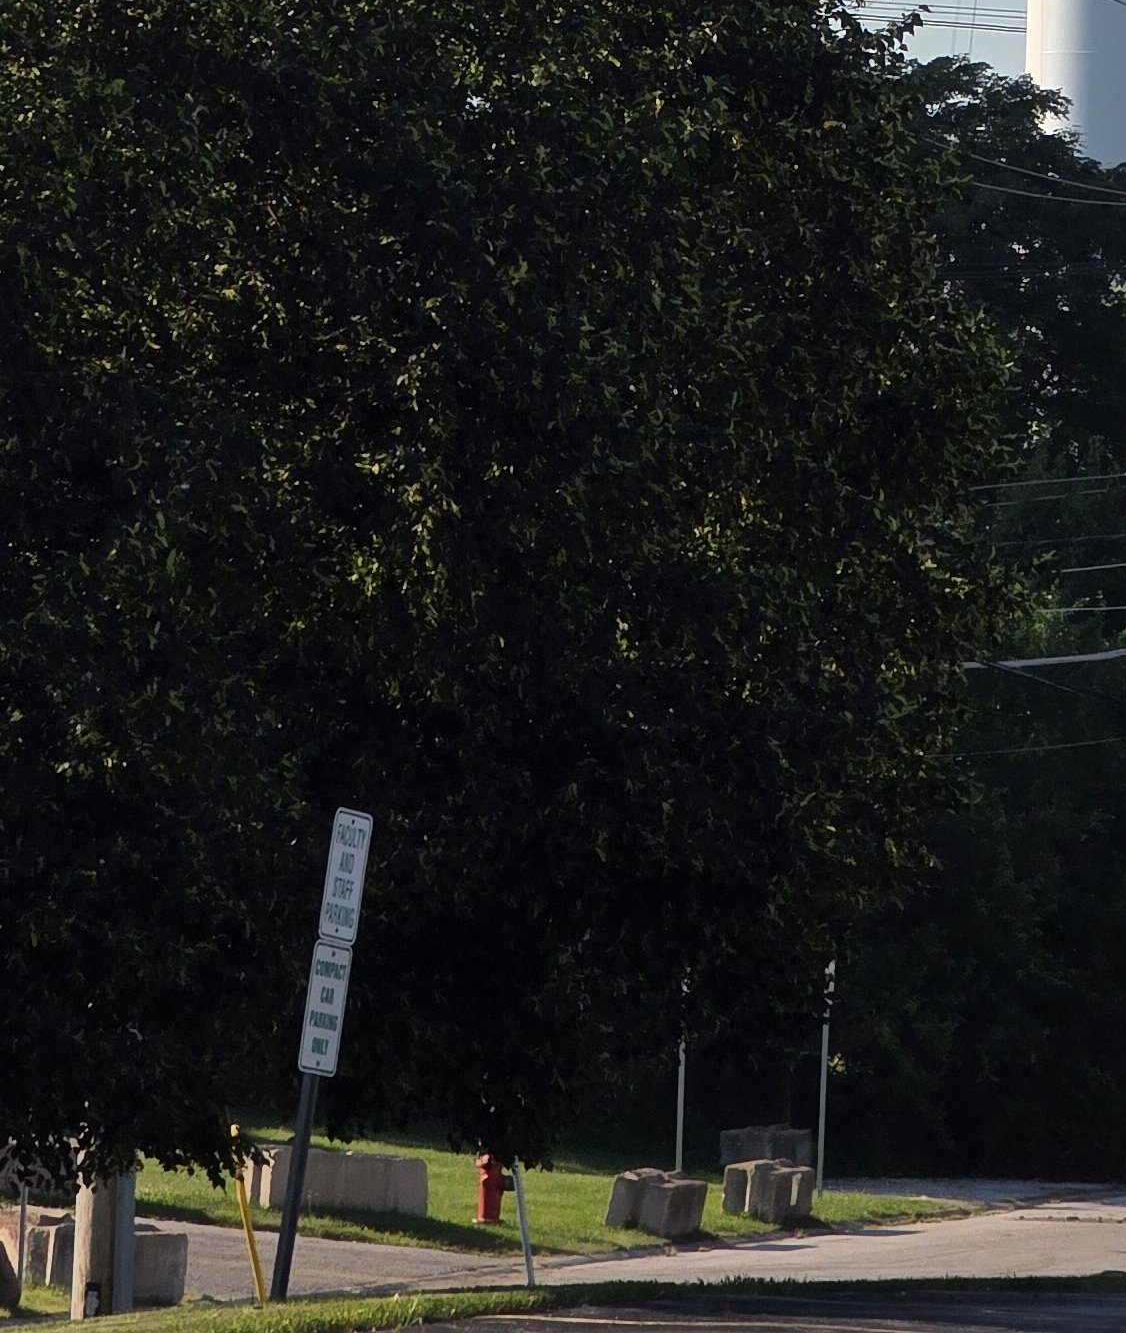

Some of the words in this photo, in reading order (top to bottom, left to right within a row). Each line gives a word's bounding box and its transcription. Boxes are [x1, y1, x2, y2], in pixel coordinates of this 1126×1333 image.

[336, 823, 367, 851] FACULTY
[339, 851, 355, 874] AND
[332, 876, 355, 901] STAFF
[324, 901, 355, 929] PARKING
[315, 959, 347, 982] COMPACT
[320, 986, 335, 1005] CAR
[309, 1010, 338, 1032] PARKING
[311, 1037, 329, 1056] ONLY
